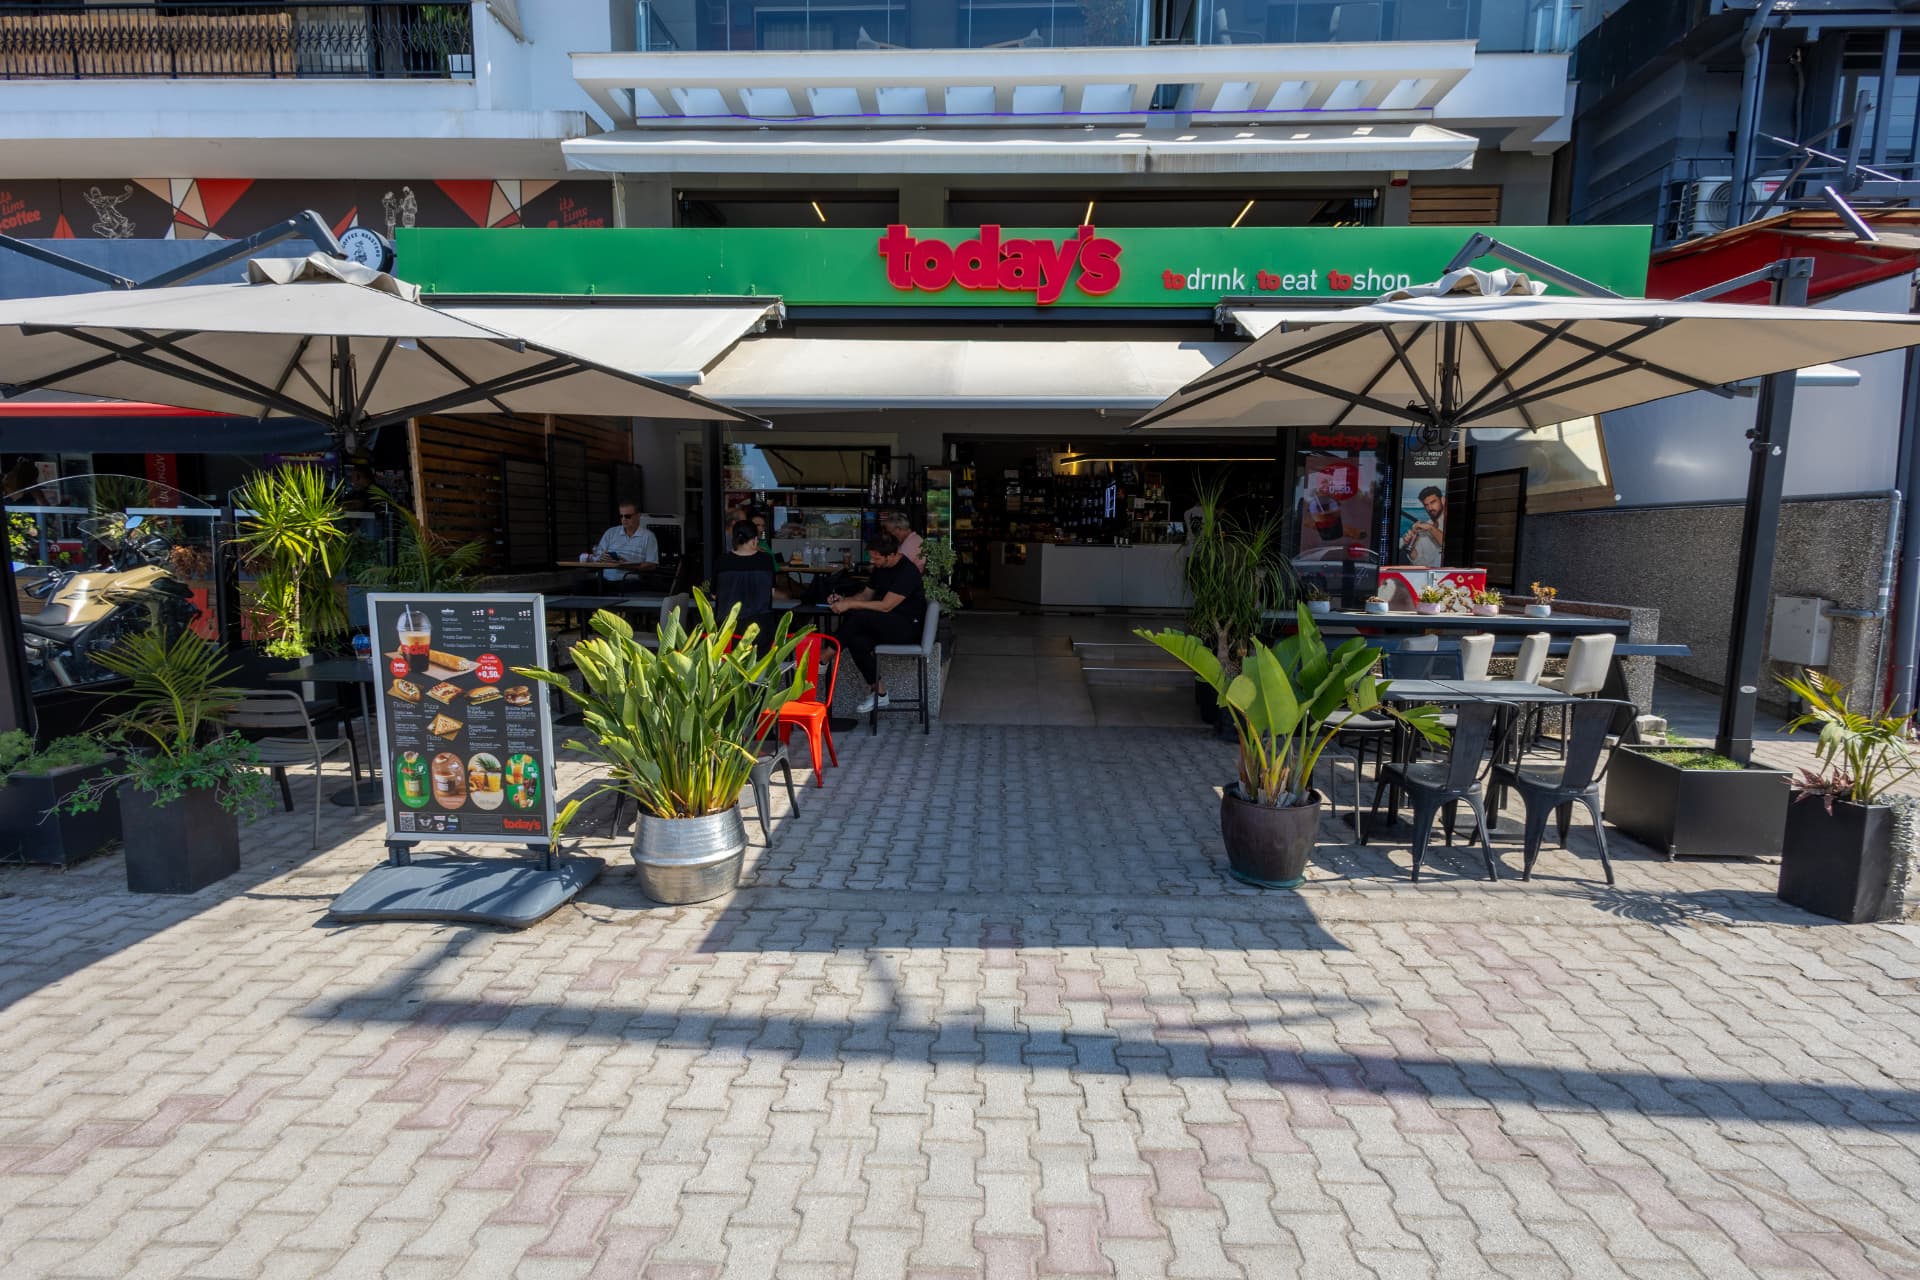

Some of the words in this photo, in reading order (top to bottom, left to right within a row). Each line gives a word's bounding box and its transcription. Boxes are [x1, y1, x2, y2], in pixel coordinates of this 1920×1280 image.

[878, 224, 1123, 305] today's
[1310, 432, 1377, 450] today's
[503, 818, 541, 831] today's
